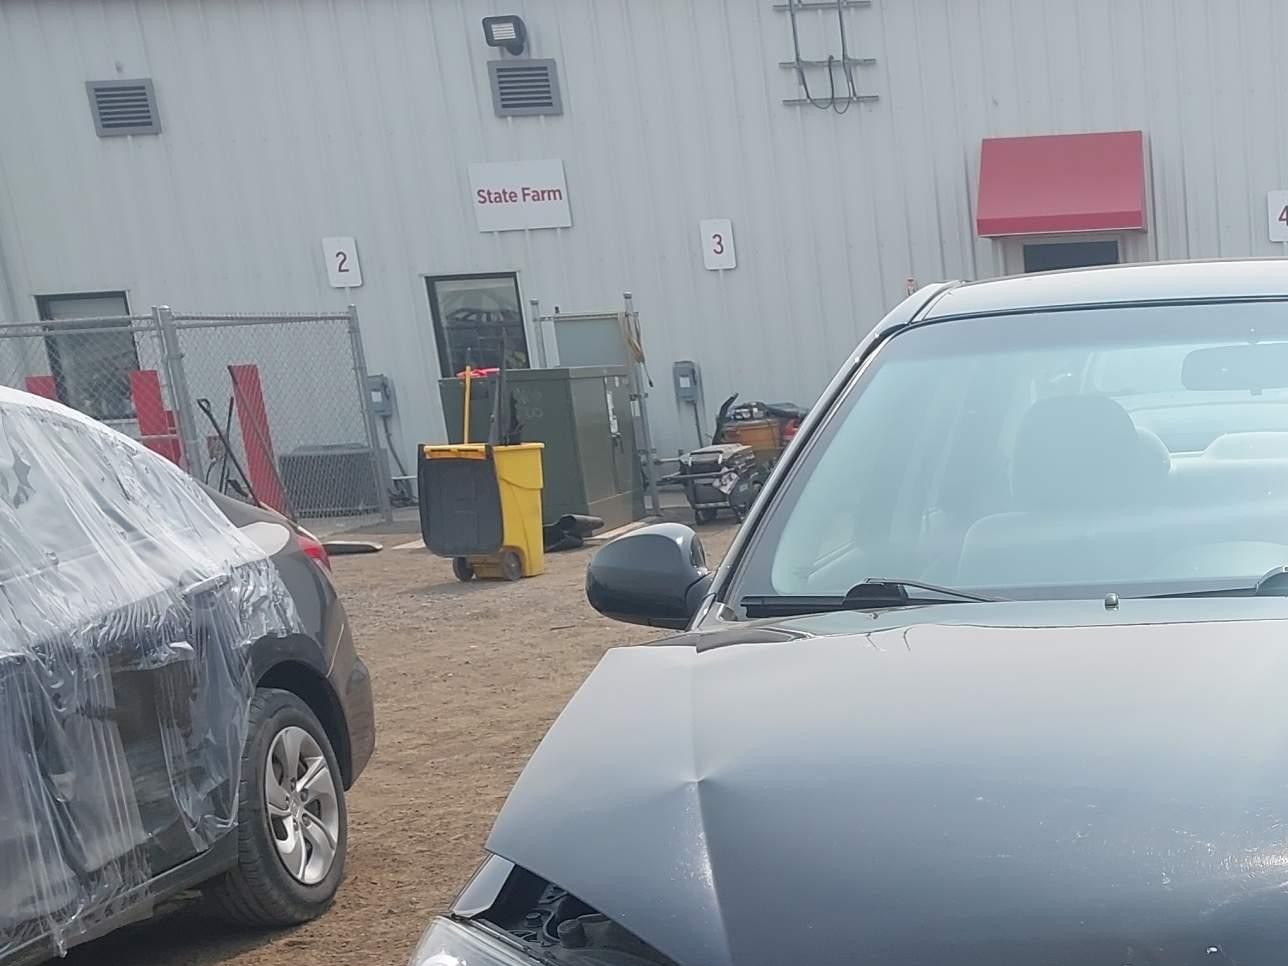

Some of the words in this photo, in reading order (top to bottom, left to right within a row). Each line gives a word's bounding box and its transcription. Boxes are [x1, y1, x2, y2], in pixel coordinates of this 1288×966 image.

[476, 188, 519, 205] State
[521, 186, 563, 203] Farm
[711, 233, 724, 255] 3
[335, 251, 350, 273] 2
